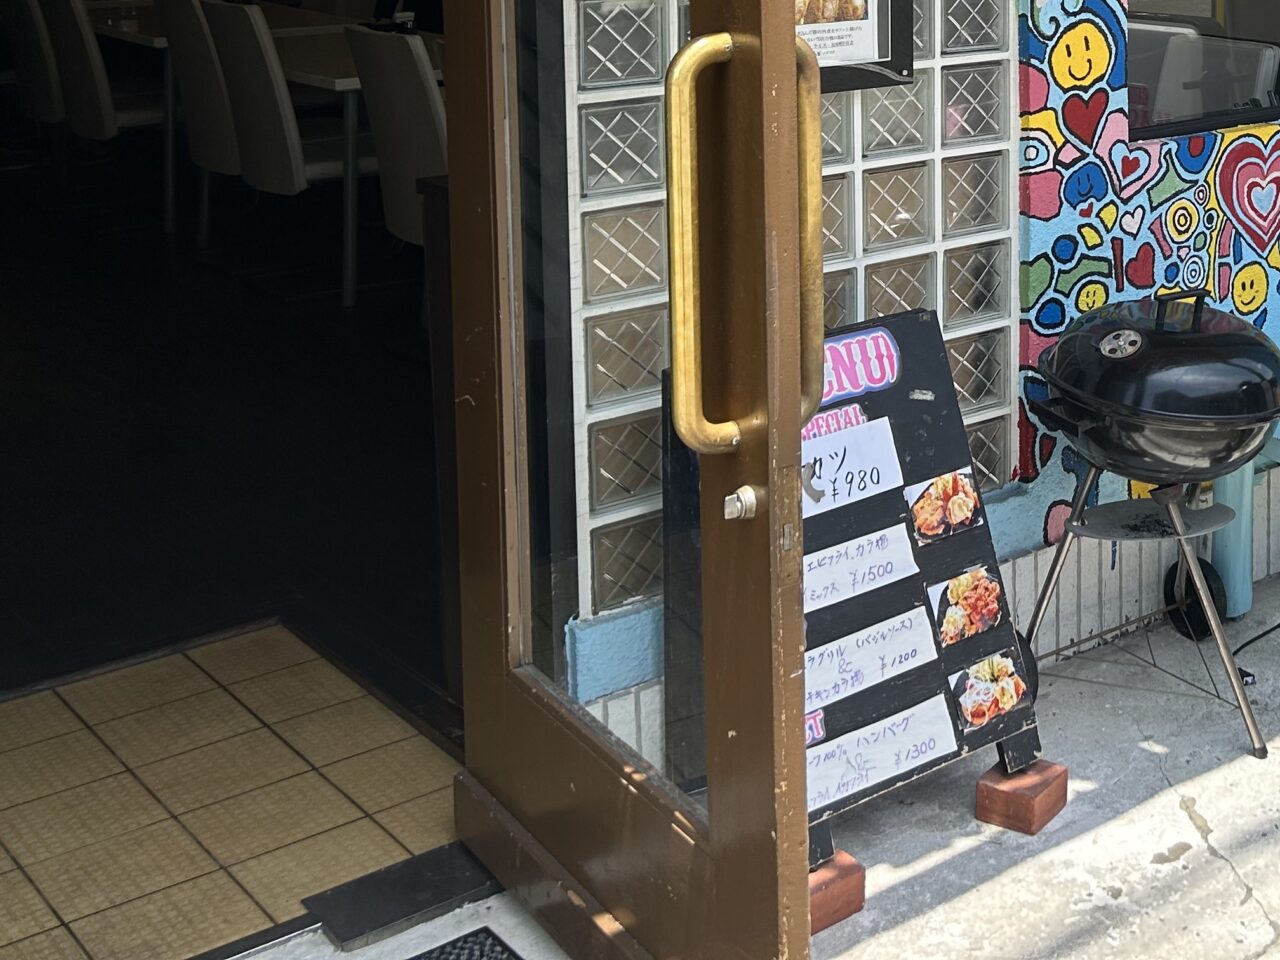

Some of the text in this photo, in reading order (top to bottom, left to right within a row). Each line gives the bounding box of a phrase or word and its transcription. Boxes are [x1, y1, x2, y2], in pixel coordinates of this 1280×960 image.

[831, 466, 881, 503] ¥980
[804, 581, 840, 603] ミックス
[878, 648, 918, 677] ¥1200
[857, 712, 916, 748] ハンバーグ
[893, 737, 937, 771] ¥1300
